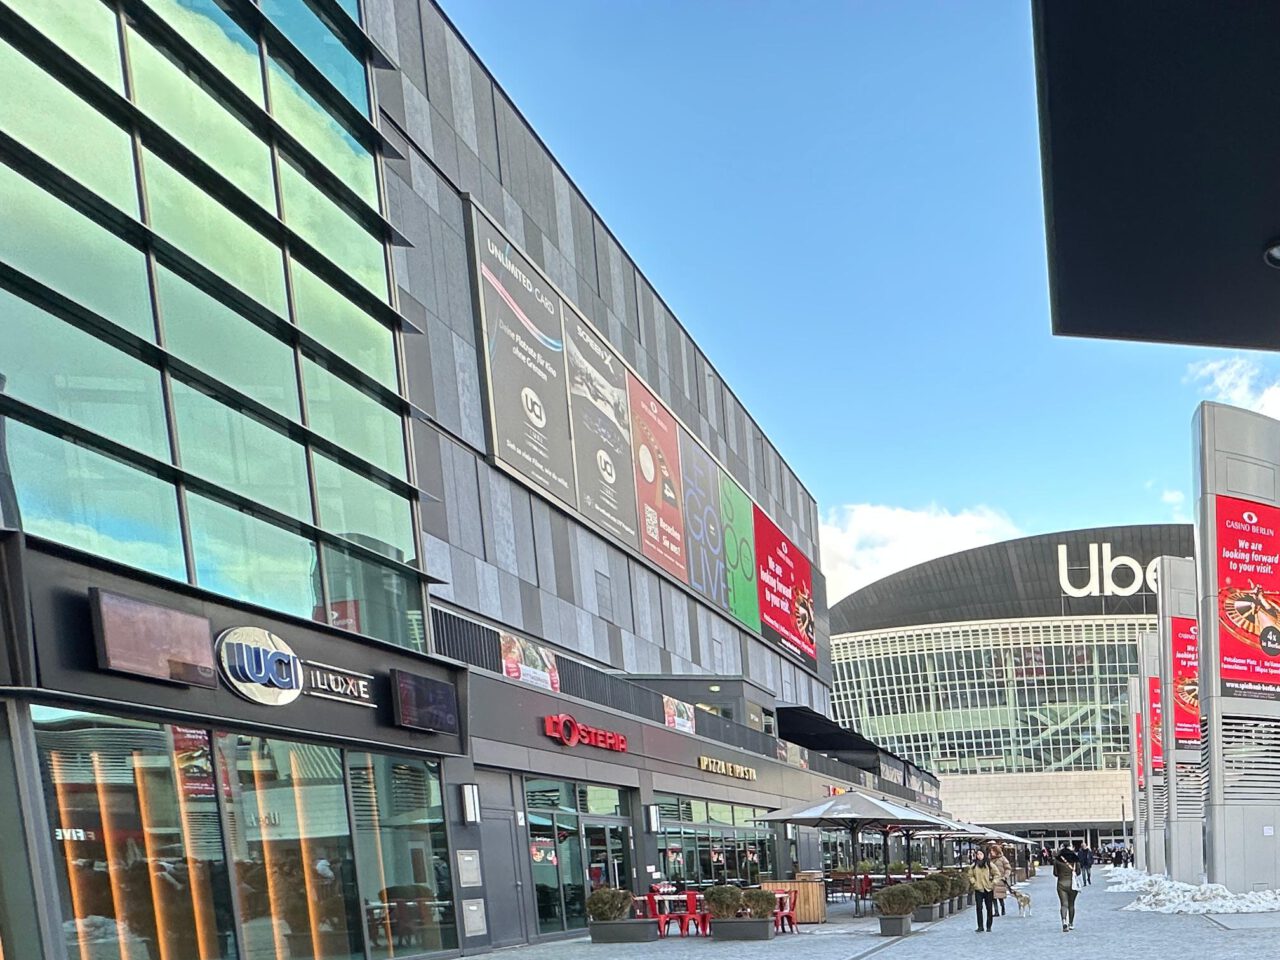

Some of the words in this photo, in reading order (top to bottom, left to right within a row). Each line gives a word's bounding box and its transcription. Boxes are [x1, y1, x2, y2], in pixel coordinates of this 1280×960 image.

[487, 238, 532, 292] UNLIMITED
[534, 288, 555, 315] CARD
[512, 345, 526, 364] ohne
[526, 358, 548, 382] Grenzen
[545, 360, 557, 378] Kino
[525, 393, 543, 422] UCI
[599, 455, 613, 477] UCI
[1225, 520, 1251, 532] CASINO
[1251, 525, 1275, 537] BERLIN
[1222, 547, 1251, 563] looking
[1251, 550, 1280, 565] forward
[1238, 539, 1250, 550] We
[1250, 541, 1263, 552] are
[767, 554, 776, 572] We
[775, 562, 783, 578] are
[1058, 542, 1160, 598] Ub
[1229, 560, 1238, 571] to
[1238, 562, 1256, 574] your
[1256, 563, 1274, 575] visit.
[760, 564, 777, 593] looking
[776, 576, 793, 600] forward
[765, 586, 771, 602] to
[770, 592, 781, 608] your
[1266, 631, 1277, 642] 4x
[225, 642, 300, 690] UCI
[699, 756, 727, 776] PIZZA
[727, 762, 734, 777] E
[733, 765, 757, 781] PASTA
